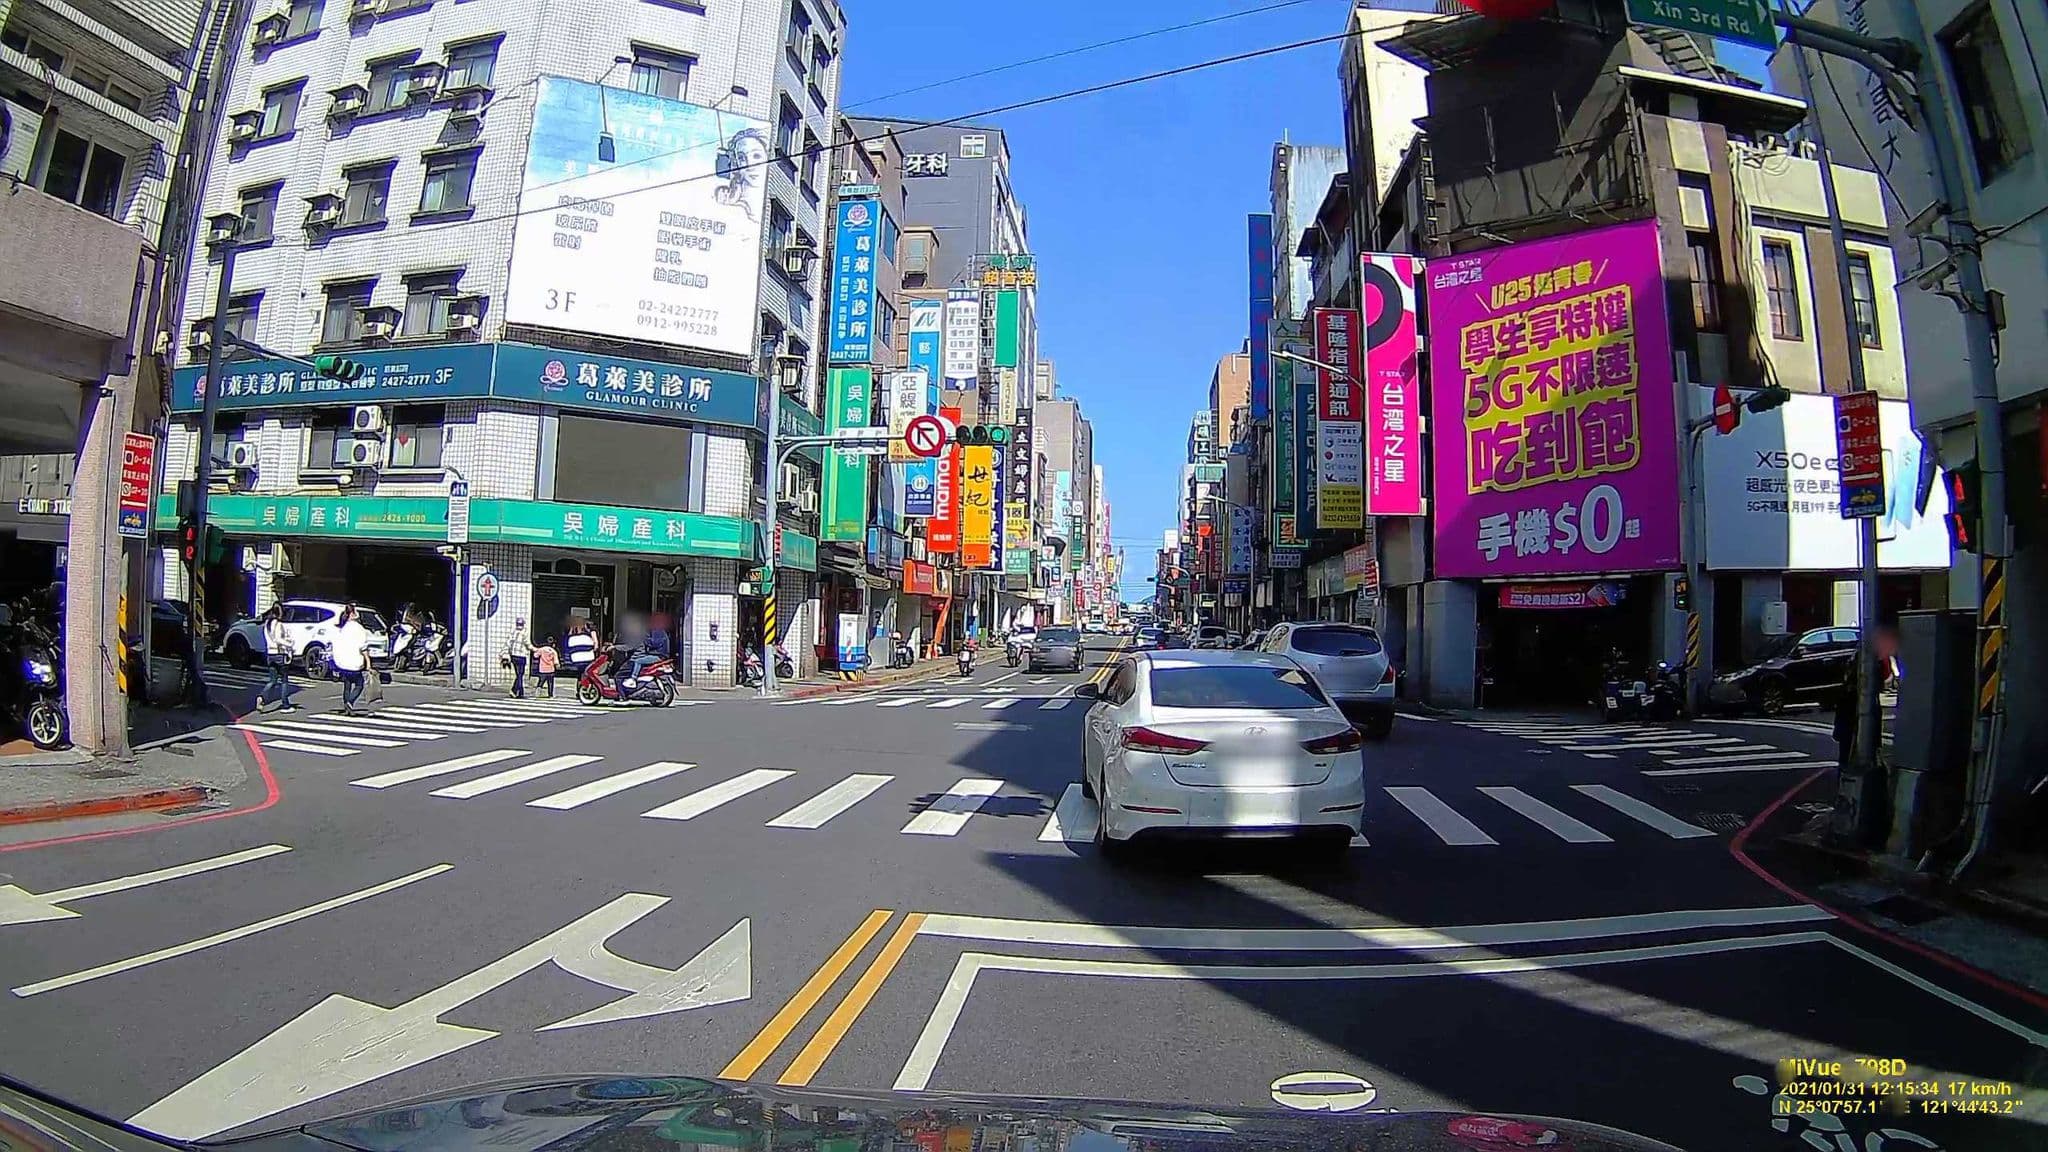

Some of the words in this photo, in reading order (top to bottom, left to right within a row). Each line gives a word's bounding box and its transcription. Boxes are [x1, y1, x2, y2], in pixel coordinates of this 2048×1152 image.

[1652, 1, 1682, 19] Xin
[1688, 7, 1721, 28] 3rd
[906, 152, 948, 174] 牙科
[545, 288, 577, 313] 3F
[1464, 290, 1629, 367] 學生享特權
[219, 371, 296, 398] 萊美診所
[434, 368, 454, 384] 3F
[575, 362, 713, 403] 葛萊美診所
[585, 390, 647, 406] GLAMOUR
[651, 398, 699, 413] CLINIC
[846, 384, 865, 470] 吳婦科
[1382, 382, 1406, 484] 台灣之星
[1470, 396, 1638, 490] 吃到飽
[261, 506, 351, 529] 吳婦產科
[562, 511, 688, 541] 吳婦產科
